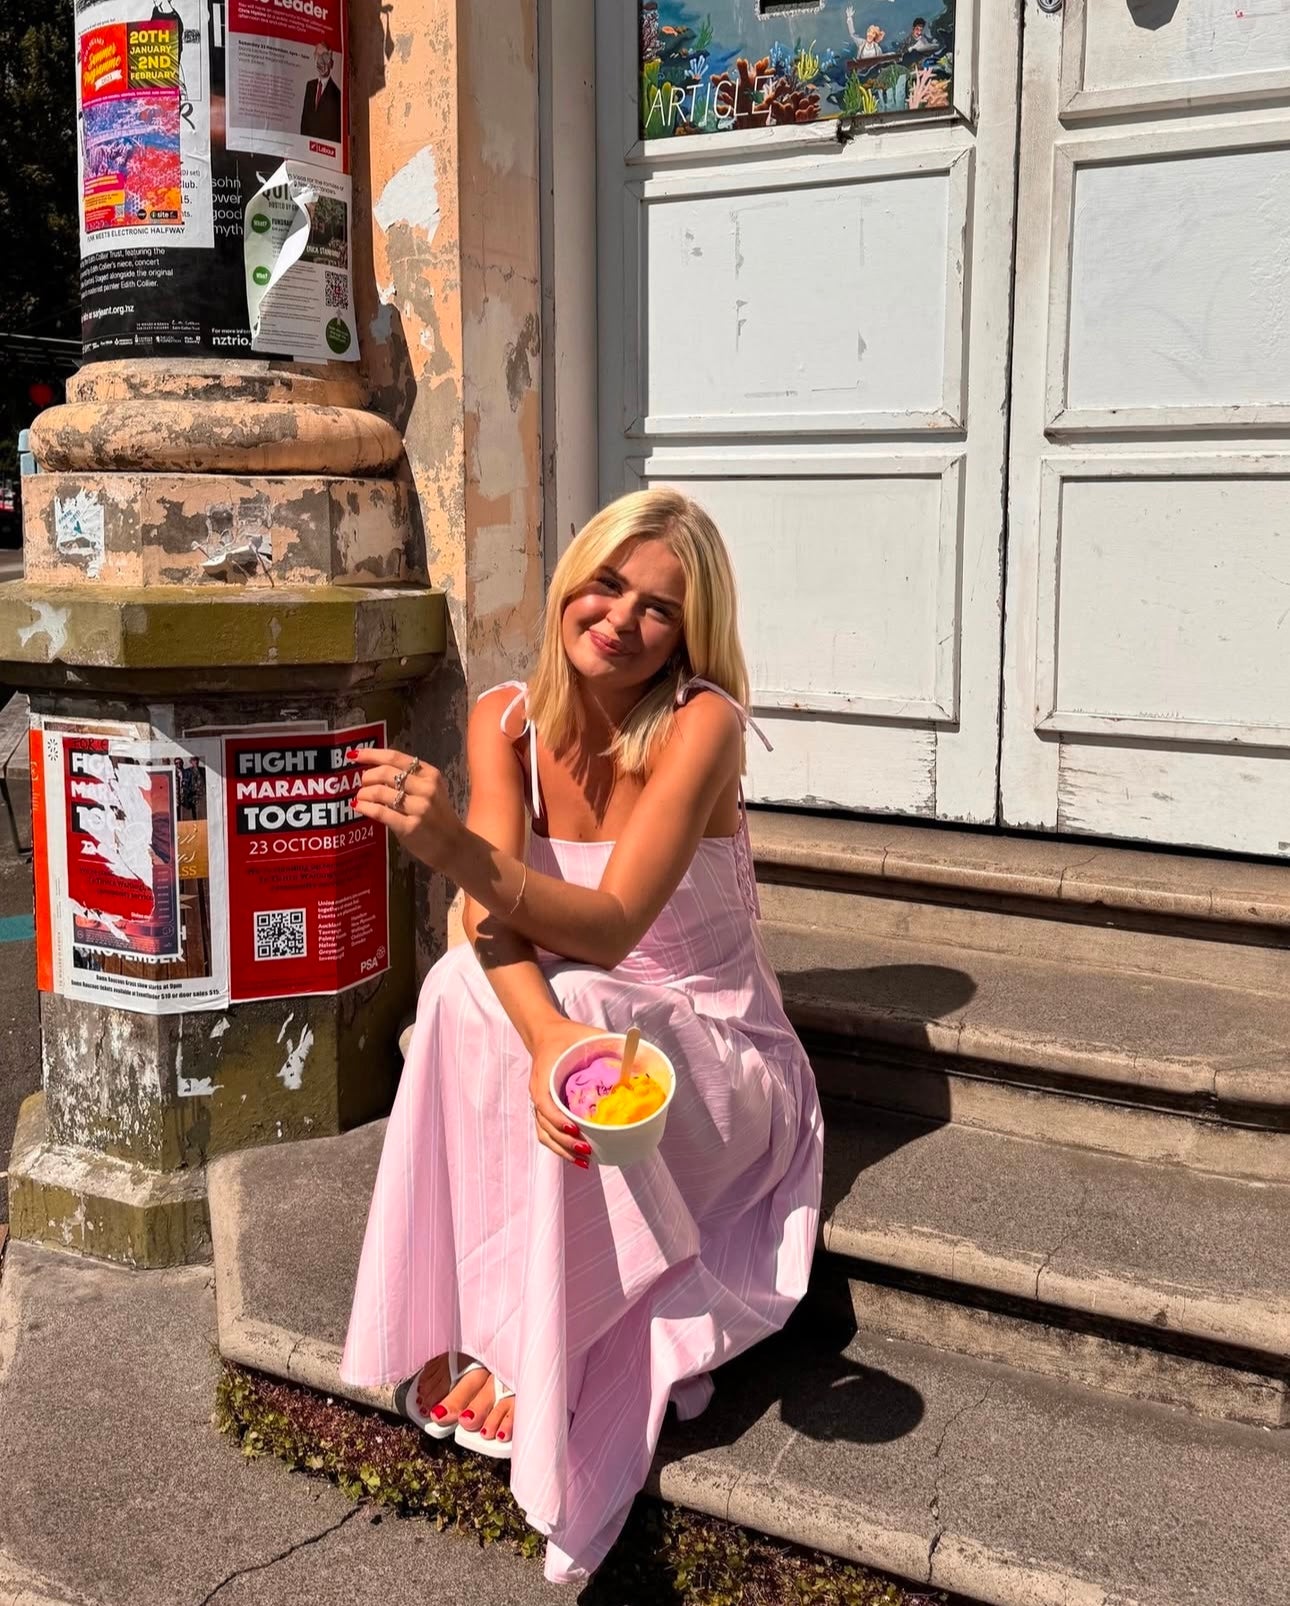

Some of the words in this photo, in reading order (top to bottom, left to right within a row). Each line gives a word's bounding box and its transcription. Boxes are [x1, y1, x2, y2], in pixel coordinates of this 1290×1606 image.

[129, 30, 170, 44] 20TH
[130, 45, 171, 55] JANUARY
[138, 55, 171, 69] 2ND
[130, 70, 177, 80] FEBRUARY
[645, 74, 775, 128] ARTICLE
[181, 181, 198, 189] lub.
[262, 183, 293, 201] QUI
[212, 207, 243, 220] good
[111, 228, 149, 237] ELECTRONIC
[125, 248, 152, 257] featuring
[153, 247, 166, 255] the
[136, 269, 147, 277] the
[148, 268, 174, 278] original
[120, 280, 136, 289] Edith
[136, 279, 159, 288] Collier.
[239, 750, 318, 774] FIGHT
[236, 775, 350, 800] MARANGA
[244, 797, 364, 831] TOGETH
[249, 840, 269, 855] 23
[273, 833, 346, 853] OCTOBER
[348, 825, 374, 844] 2024
[360, 957, 378, 973] PSA
